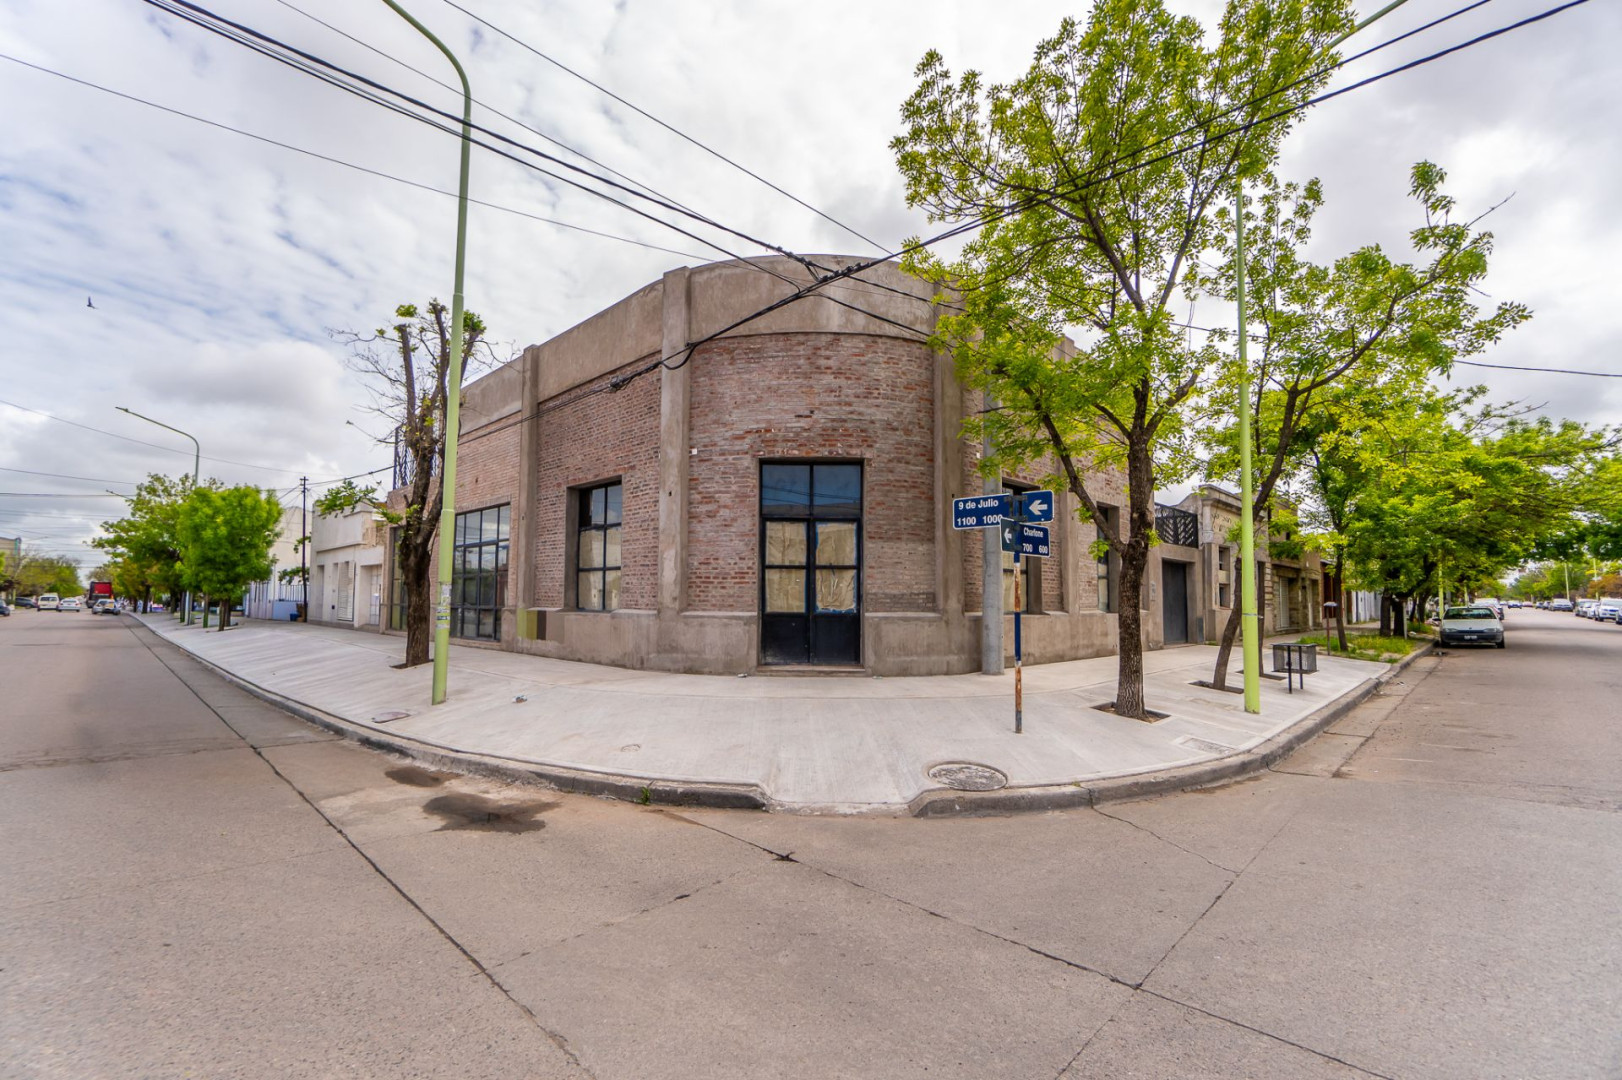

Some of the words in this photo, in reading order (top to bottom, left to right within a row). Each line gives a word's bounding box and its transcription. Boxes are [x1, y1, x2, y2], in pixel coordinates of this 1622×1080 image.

[958, 501, 964, 510] 9
[965, 500, 977, 509] de
[978, 498, 999, 508] Julio
[957, 516, 977, 526] 1100
[982, 514, 1002, 524] 1000
[1022, 543, 1033, 552] 700
[1038, 544, 1048, 554] 600
